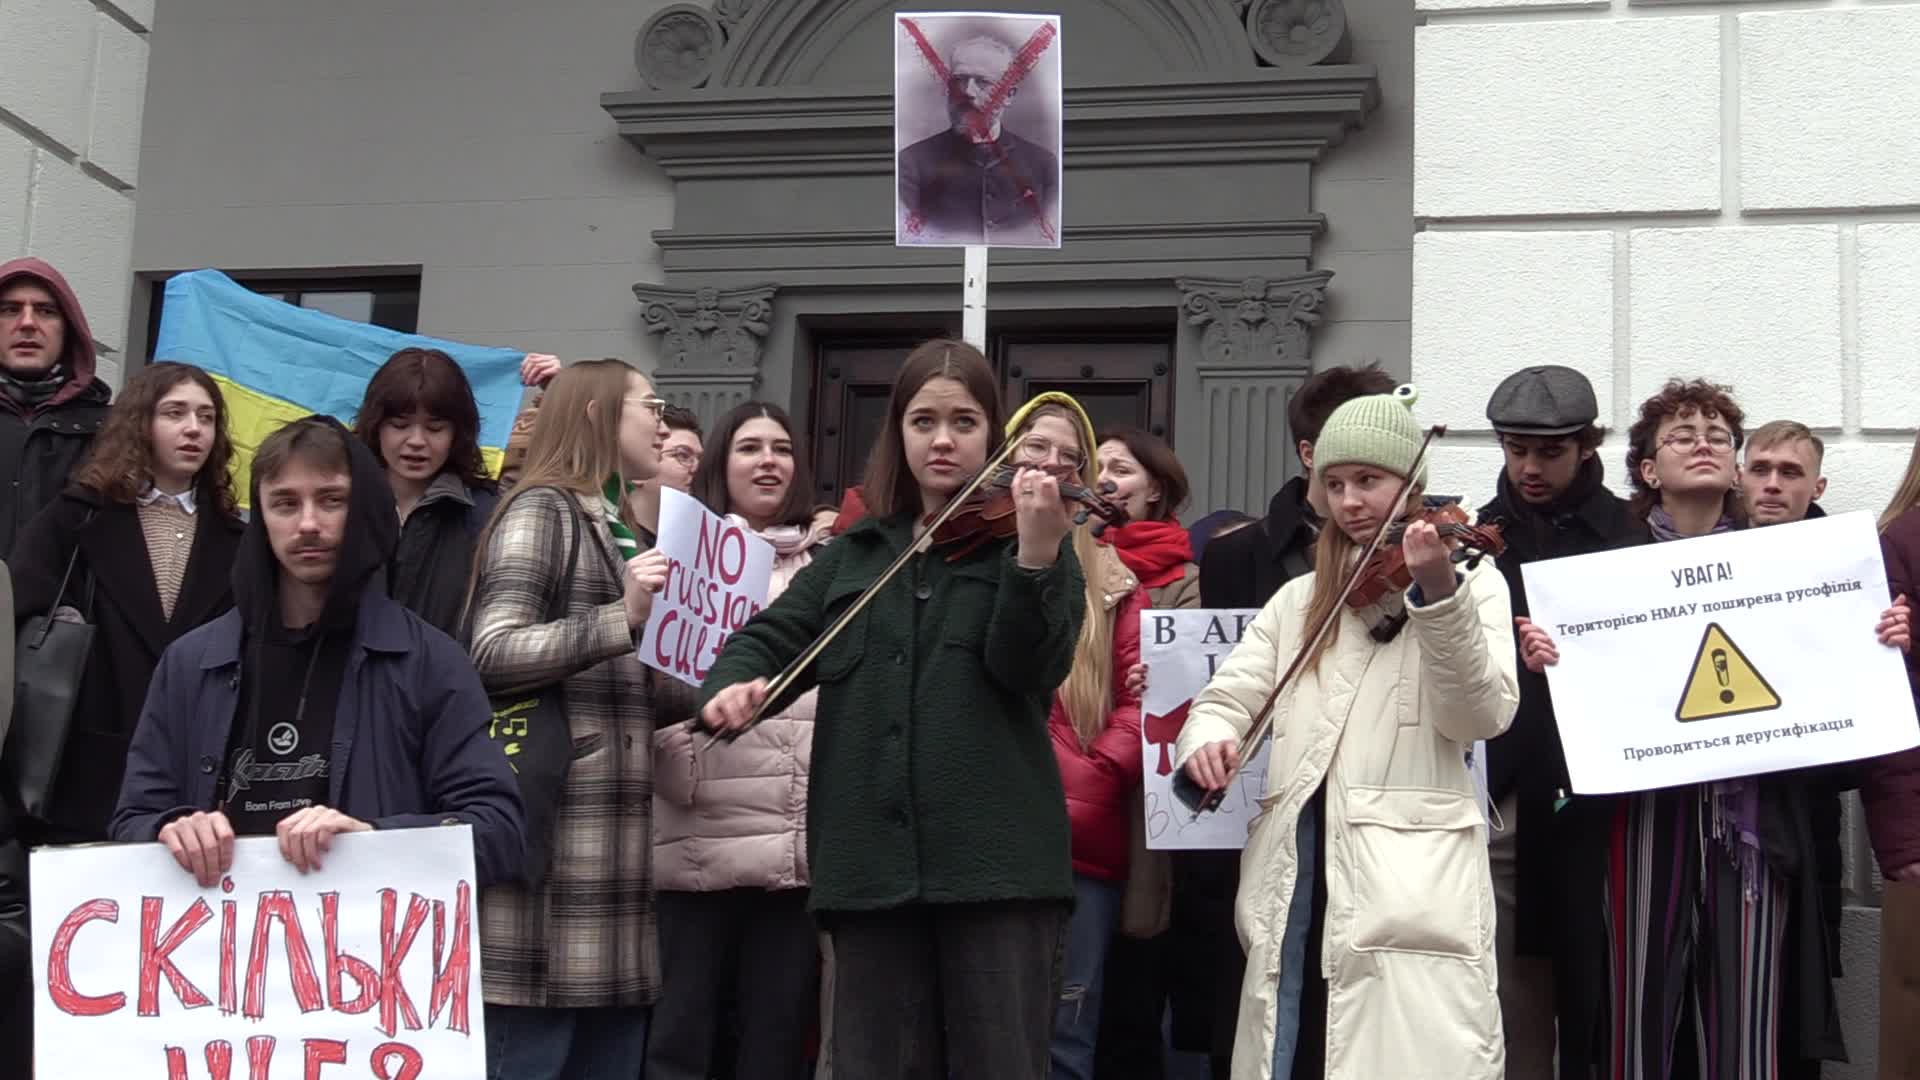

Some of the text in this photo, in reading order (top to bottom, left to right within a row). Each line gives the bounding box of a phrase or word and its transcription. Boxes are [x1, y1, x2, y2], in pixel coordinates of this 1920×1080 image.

[693, 511, 746, 586] NO
[1671, 561, 1733, 589] УВАГА!
[1556, 578, 1863, 637] Територією НМАУ поширена русофілія
[1623, 718, 1854, 761] Проводиться дерусифікація
[268, 800, 292, 811] From
